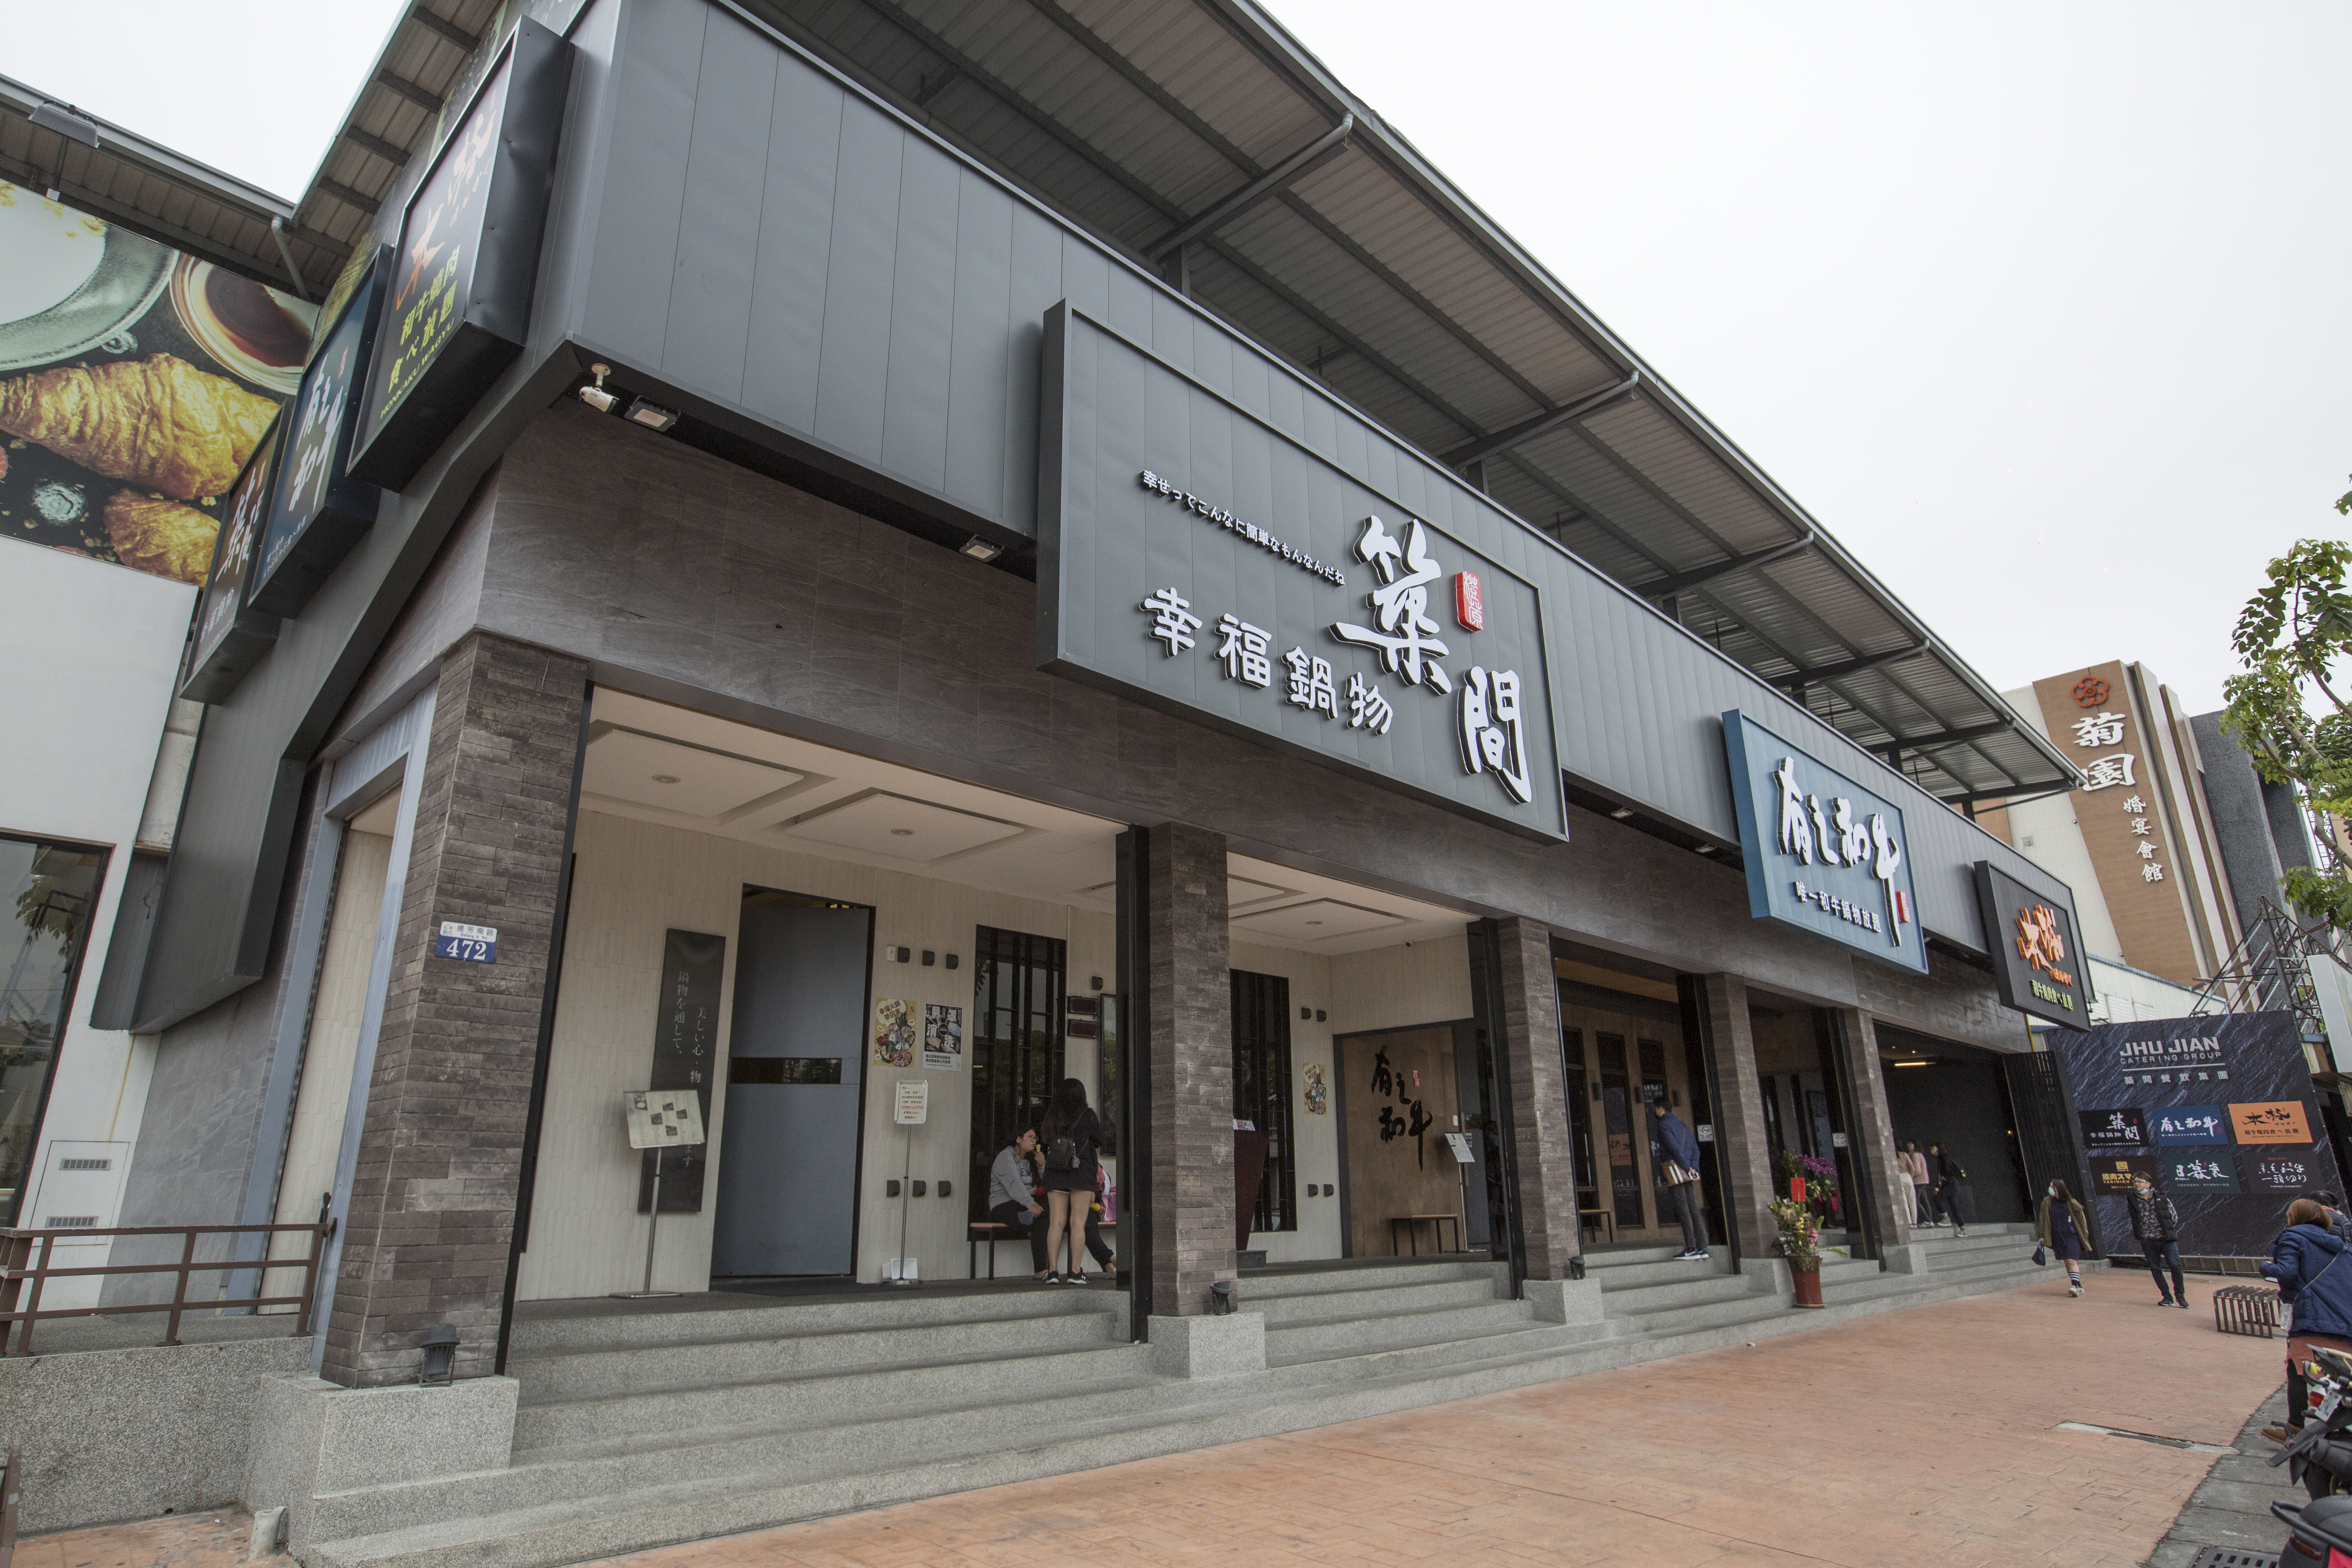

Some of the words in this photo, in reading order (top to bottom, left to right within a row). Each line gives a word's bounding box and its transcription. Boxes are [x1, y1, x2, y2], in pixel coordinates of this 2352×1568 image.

[400, 243, 461, 326] 和牛燒肉
[388, 279, 458, 394] 食べ放題
[380, 365, 420, 419] HONKAKU
[422, 317, 454, 366] WAGYU
[1142, 469, 1345, 586] 幸せってこんなに簡単なもんなんだね
[1140, 587, 1393, 735] 幸福鍋物
[1329, 515, 1532, 804] 築間
[2071, 712, 2136, 791] 菊園
[2123, 795, 2164, 883] 婚宴會館
[1793, 880, 1882, 933] 唯一和牛鍋物放題
[446, 938, 487, 960] 472
[457, 924, 494, 936] 德芳南路
[879, 1000, 901, 1015] 幸福火鍋
[884, 1008, 901, 1021] 帶回家
[2030, 979, 2074, 1011] 和牛燒肉食べ放題
[2120, 1040, 2164, 1057] JHU
[2168, 1036, 2220, 1054] JIAN
[2120, 1054, 2178, 1065] CATERING
[2184, 1051, 2221, 1060] GROUP
[2125, 1071, 2229, 1085] 築間餐飲集團
[2106, 1111, 2140, 1140] 築間
